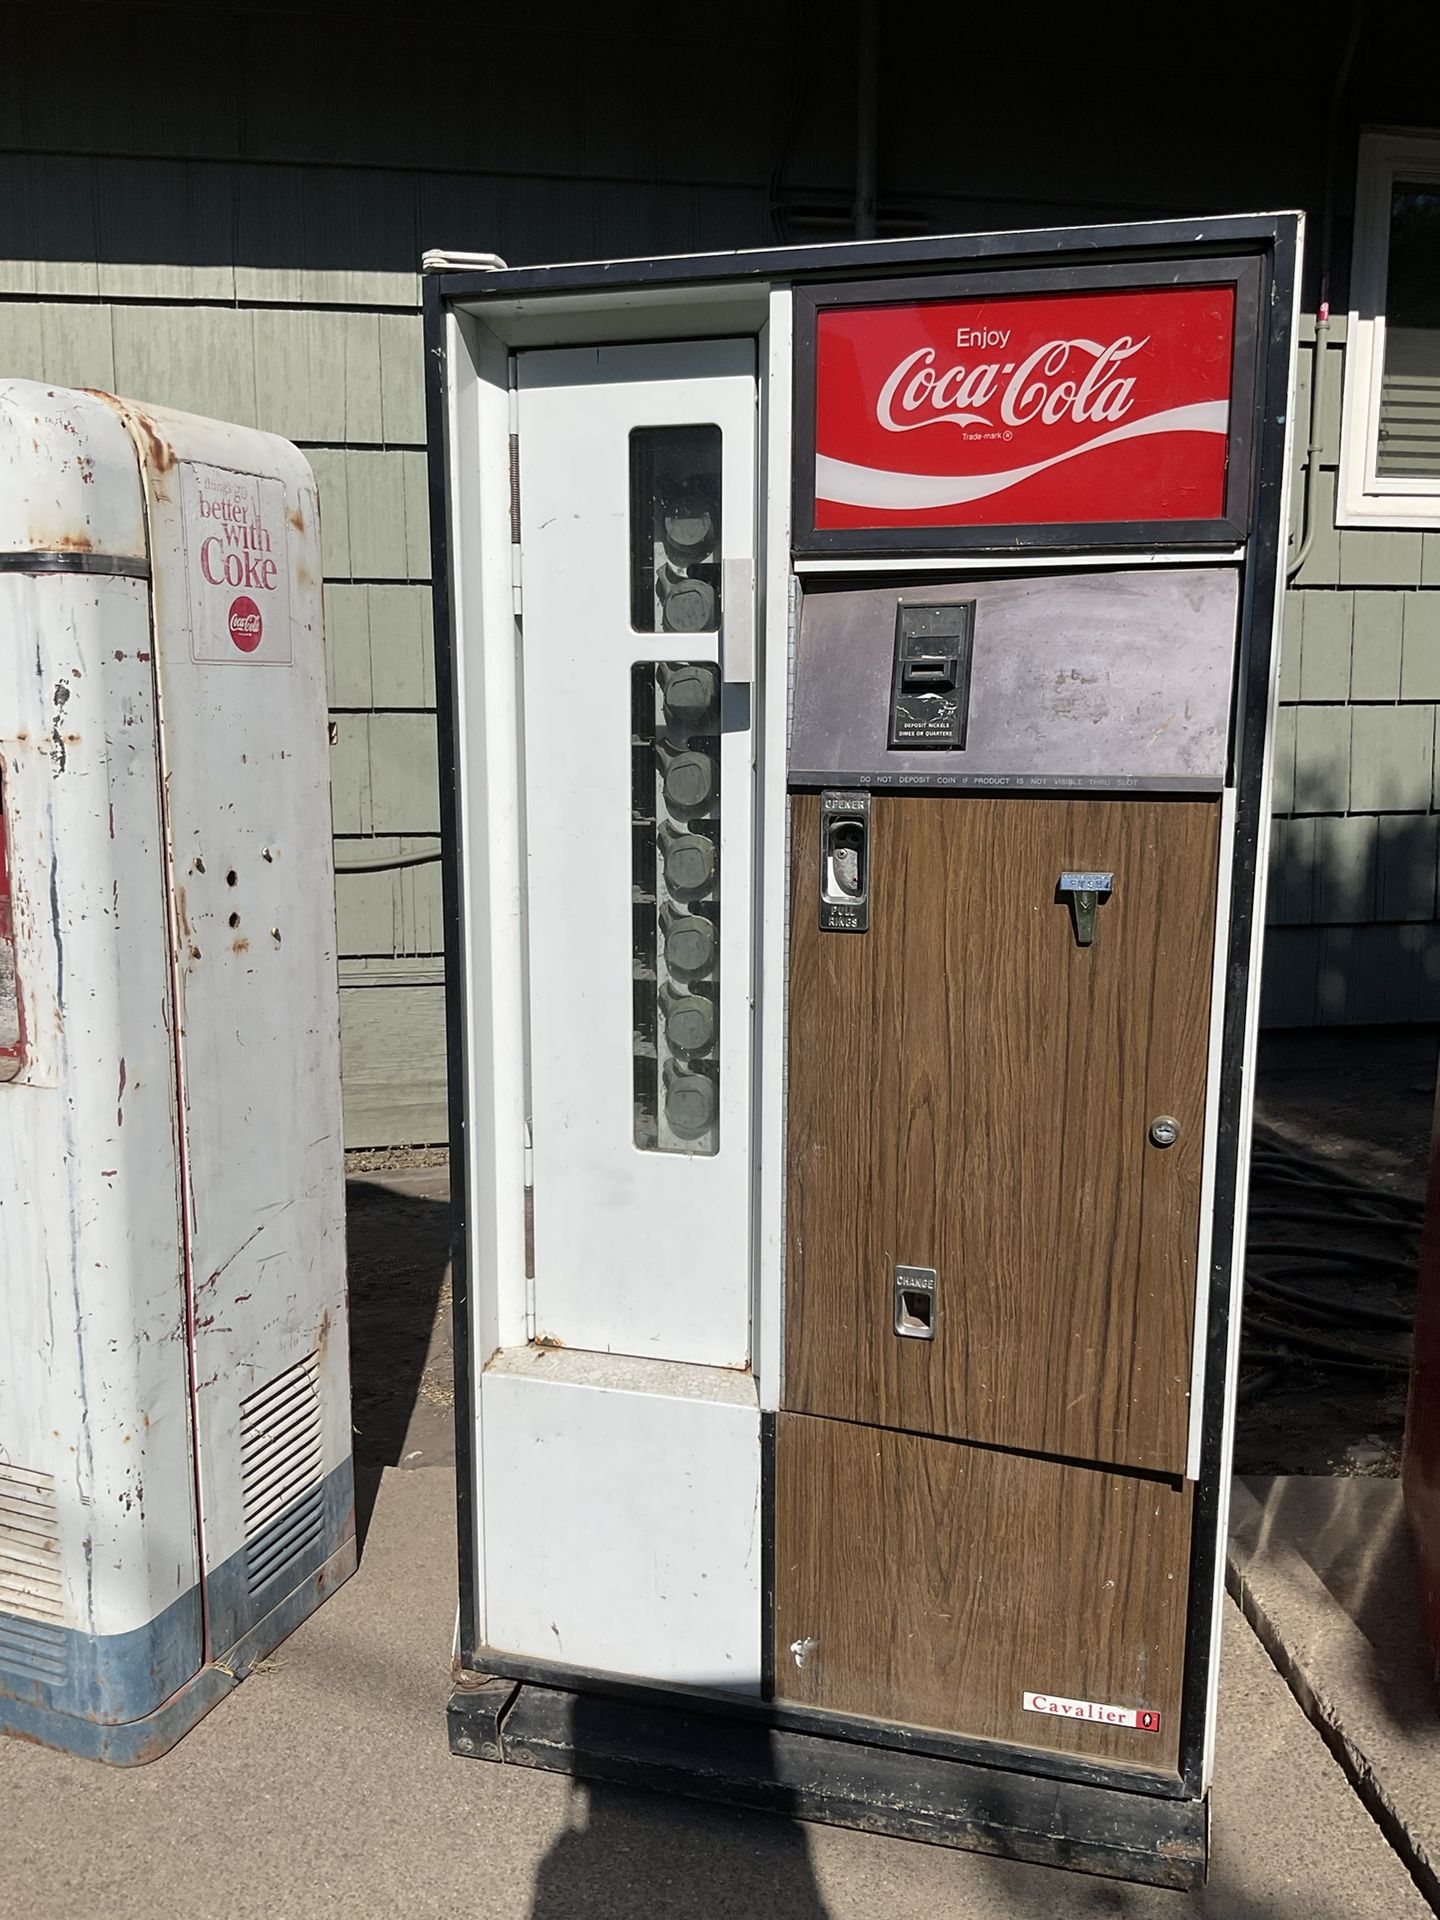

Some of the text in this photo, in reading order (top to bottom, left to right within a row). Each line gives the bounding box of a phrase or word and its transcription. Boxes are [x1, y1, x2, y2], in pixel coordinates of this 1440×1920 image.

[957, 327, 1010, 349] Enjoy
[876, 335, 1150, 433] Coca-Cola
[199, 490, 248, 524] better
[222, 515, 272, 552] with
[201, 536, 277, 591] Coke
[860, 775, 871, 783] DO
[876, 775, 892, 783] NOT
[899, 776, 930, 784] DEPOSIT
[937, 776, 956, 784] COIN
[962, 777, 969, 785] IF
[973, 777, 1010, 785] PRODUCT
[1016, 777, 1024, 785] IS
[1053, 778, 1083, 786] VISIBLE
[1089, 778, 1111, 786] THRU
[825, 800, 865, 810] OPENER
[828, 917, 858, 928] RINGS
[831, 906, 856, 917] PULL
[896, 1276, 934, 1289] CHANGE
[1032, 1696, 1126, 1723] Cavalier
